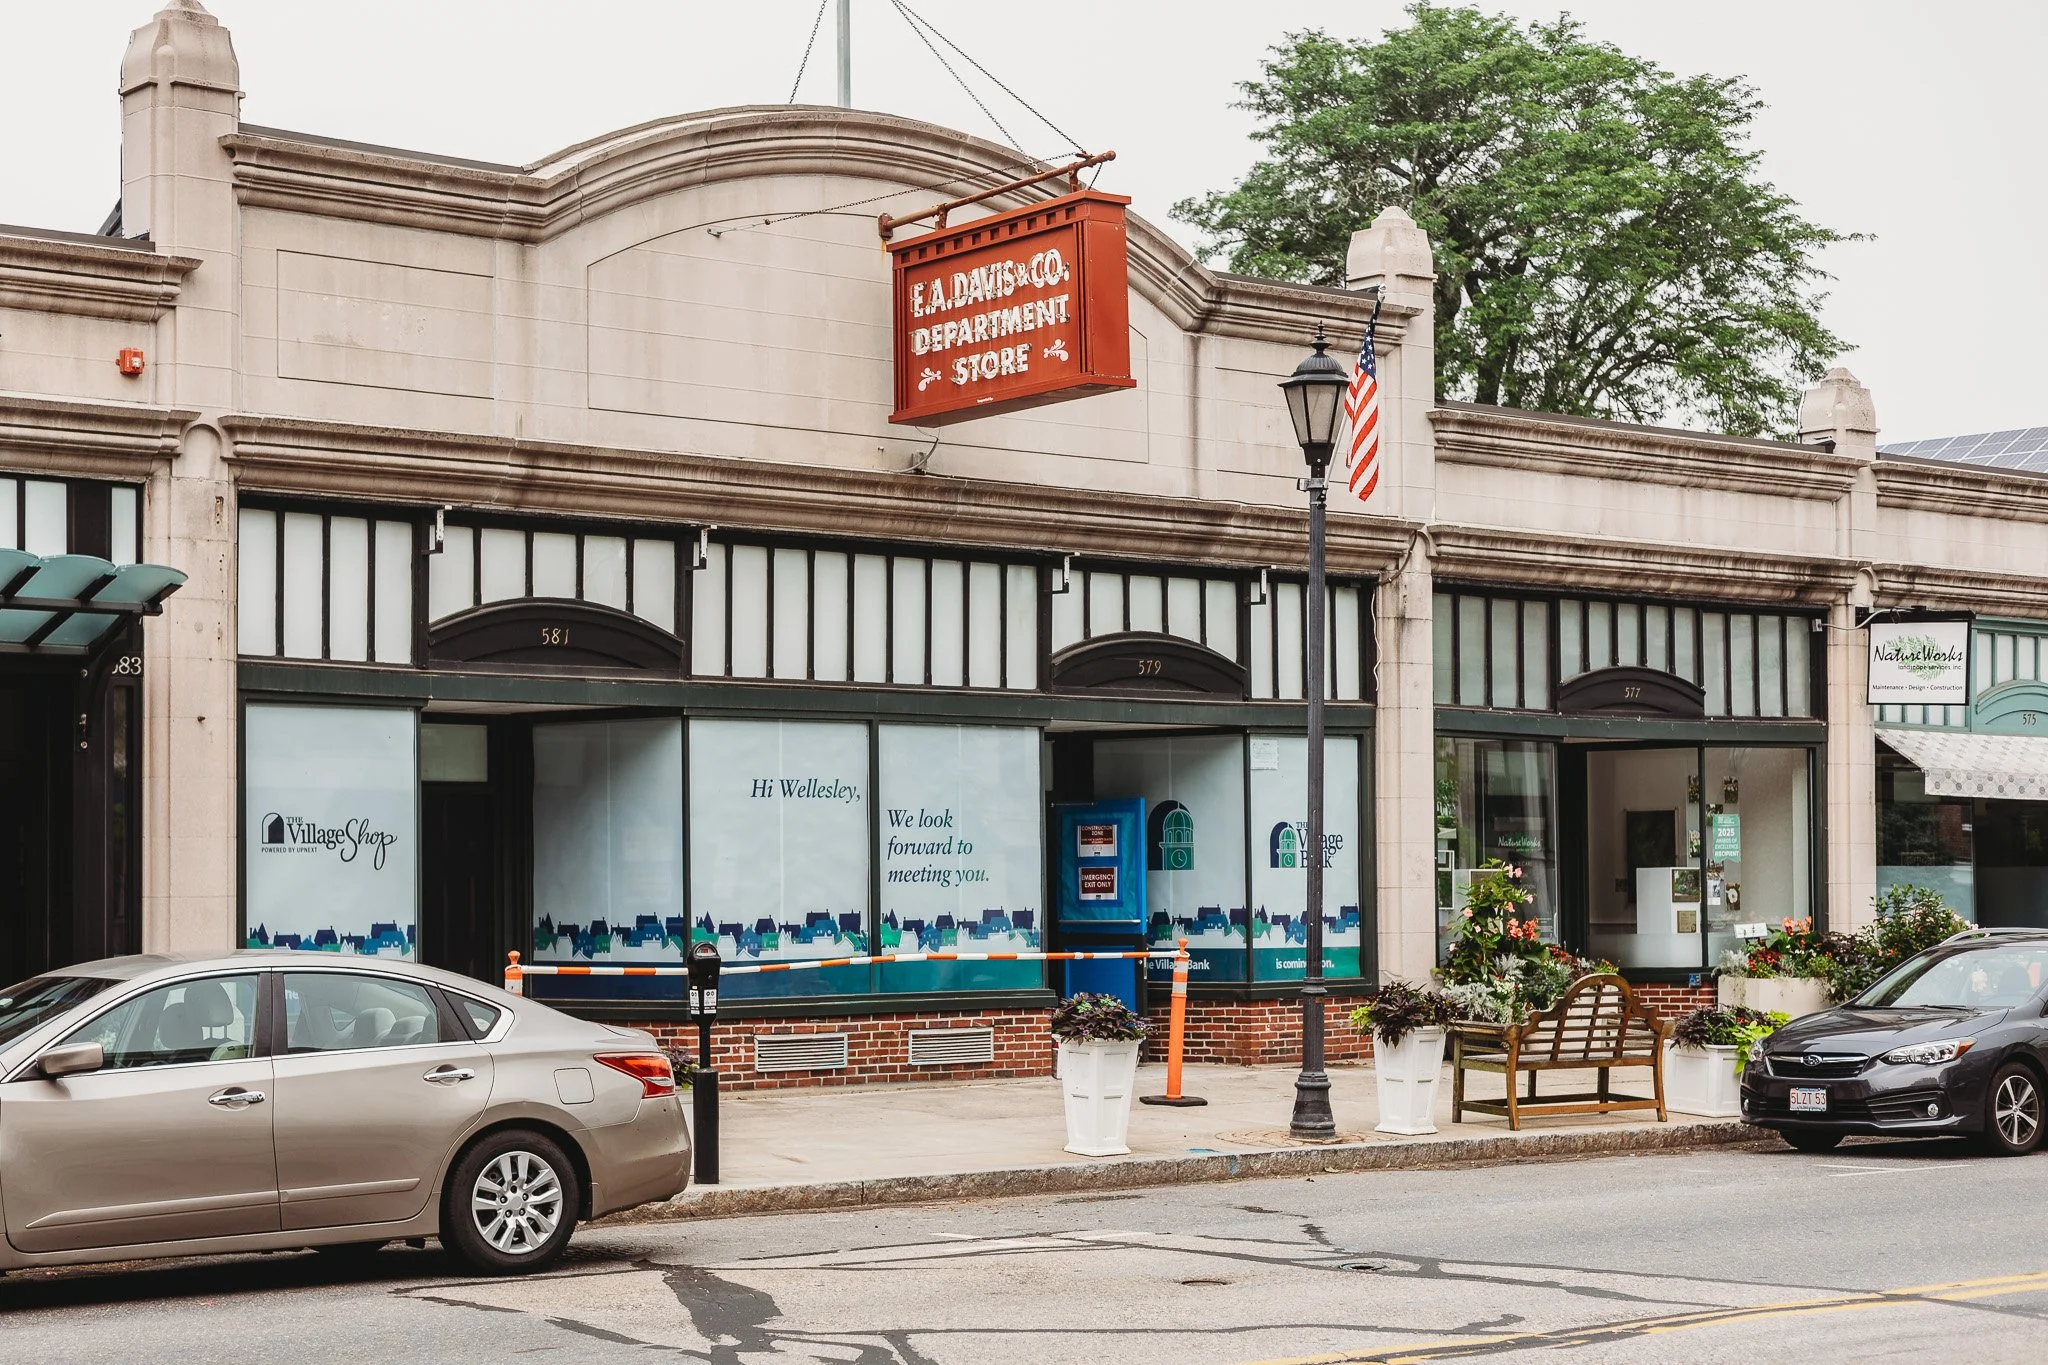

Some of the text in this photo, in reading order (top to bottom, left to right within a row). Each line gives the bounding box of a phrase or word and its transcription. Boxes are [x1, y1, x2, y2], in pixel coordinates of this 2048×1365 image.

[910, 294, 1071, 356] DEPARTMENT
[951, 343, 1032, 386] STORE
[541, 627, 570, 645] 581
[1873, 644, 1963, 662] NatureWorks
[1138, 660, 1162, 675] 579
[1624, 687, 1641, 699] 577
[1908, 684, 1926, 692] Design
[2022, 713, 2037, 726] 575
[750, 778, 861, 804] Hi Wellesley,
[887, 808, 953, 828] We look
[1717, 828, 1735, 837] 2025
[887, 835, 973, 860] forward to
[887, 864, 990, 887] meeting you.
[1275, 957, 1283, 969] is
[1283, 957, 1307, 969] comin
[1791, 1092, 1826, 1105] 5LZT 53
